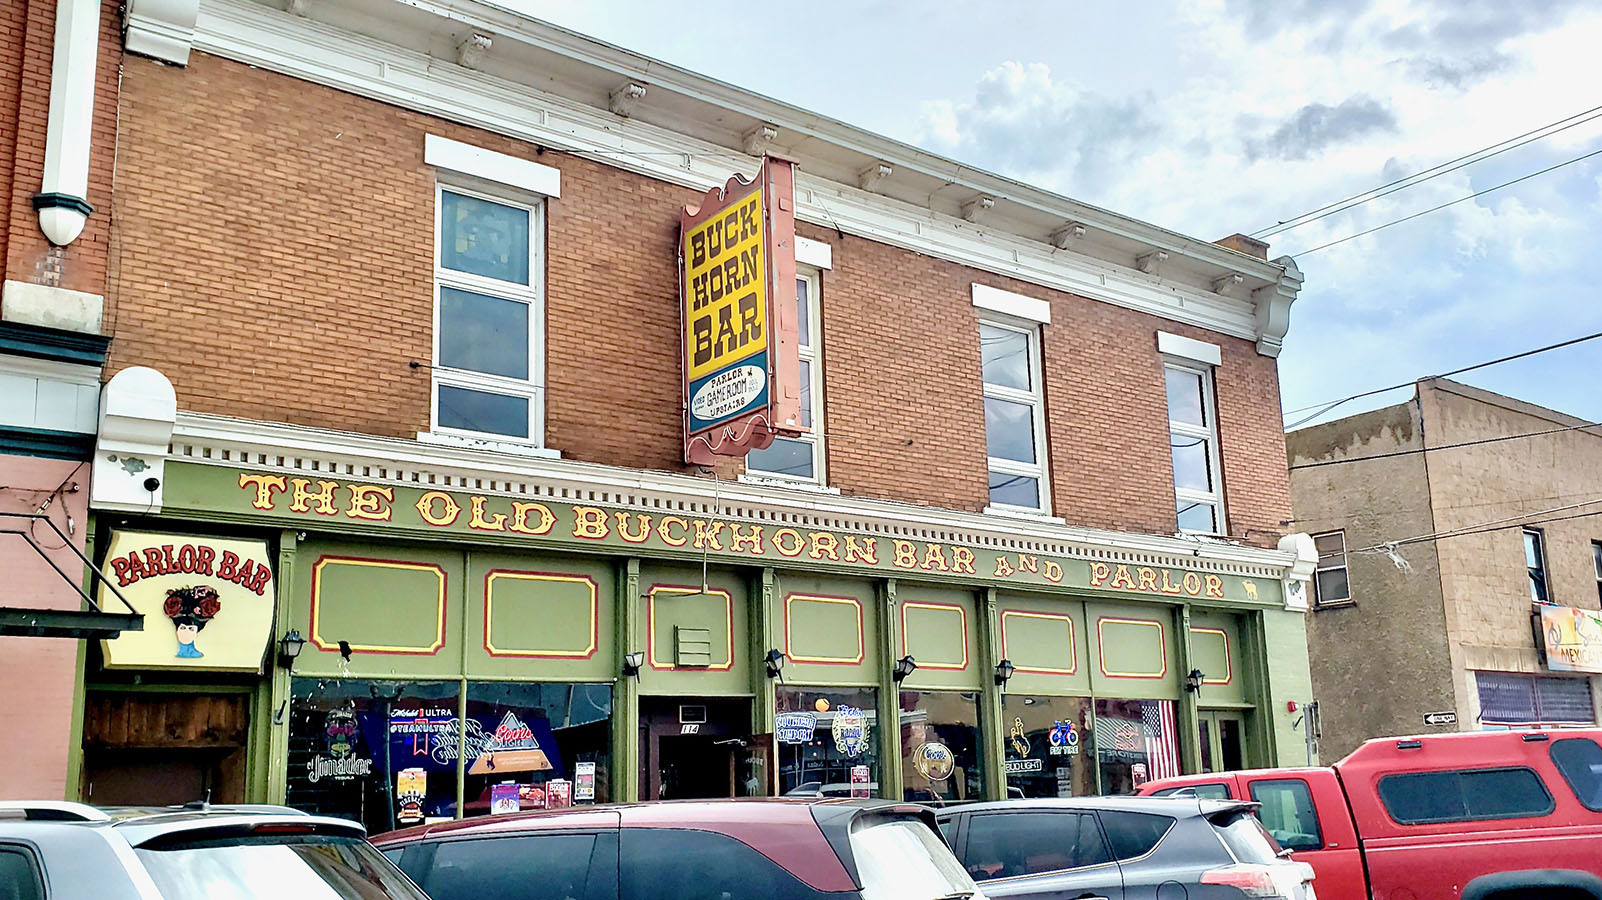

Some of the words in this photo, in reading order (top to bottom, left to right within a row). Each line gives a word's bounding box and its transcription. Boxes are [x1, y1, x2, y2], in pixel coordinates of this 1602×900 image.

[691, 199, 758, 270] BUCK
[692, 244, 759, 312] HORN
[693, 291, 762, 368] BAR
[711, 368, 743, 388] PARLOR
[710, 397, 745, 416] UPSTAIRS
[239, 473, 393, 522] THE
[415, 490, 559, 536] OLD
[571, 505, 879, 565] BUCKHORN
[892, 540, 976, 575] BAR
[993, 553, 1064, 583] AND
[1089, 561, 1225, 598] PARLOR
[110, 543, 216, 588] PARLOR
[216, 549, 272, 596] BAR
[425, 708, 452, 717] ULTRA
[494, 724, 533, 741] Coors
[683, 725, 698, 733] 114
[308, 752, 372, 782] Jimador
[1005, 763, 1020, 772] BUD
[1021, 761, 1040, 770] LIGHT
